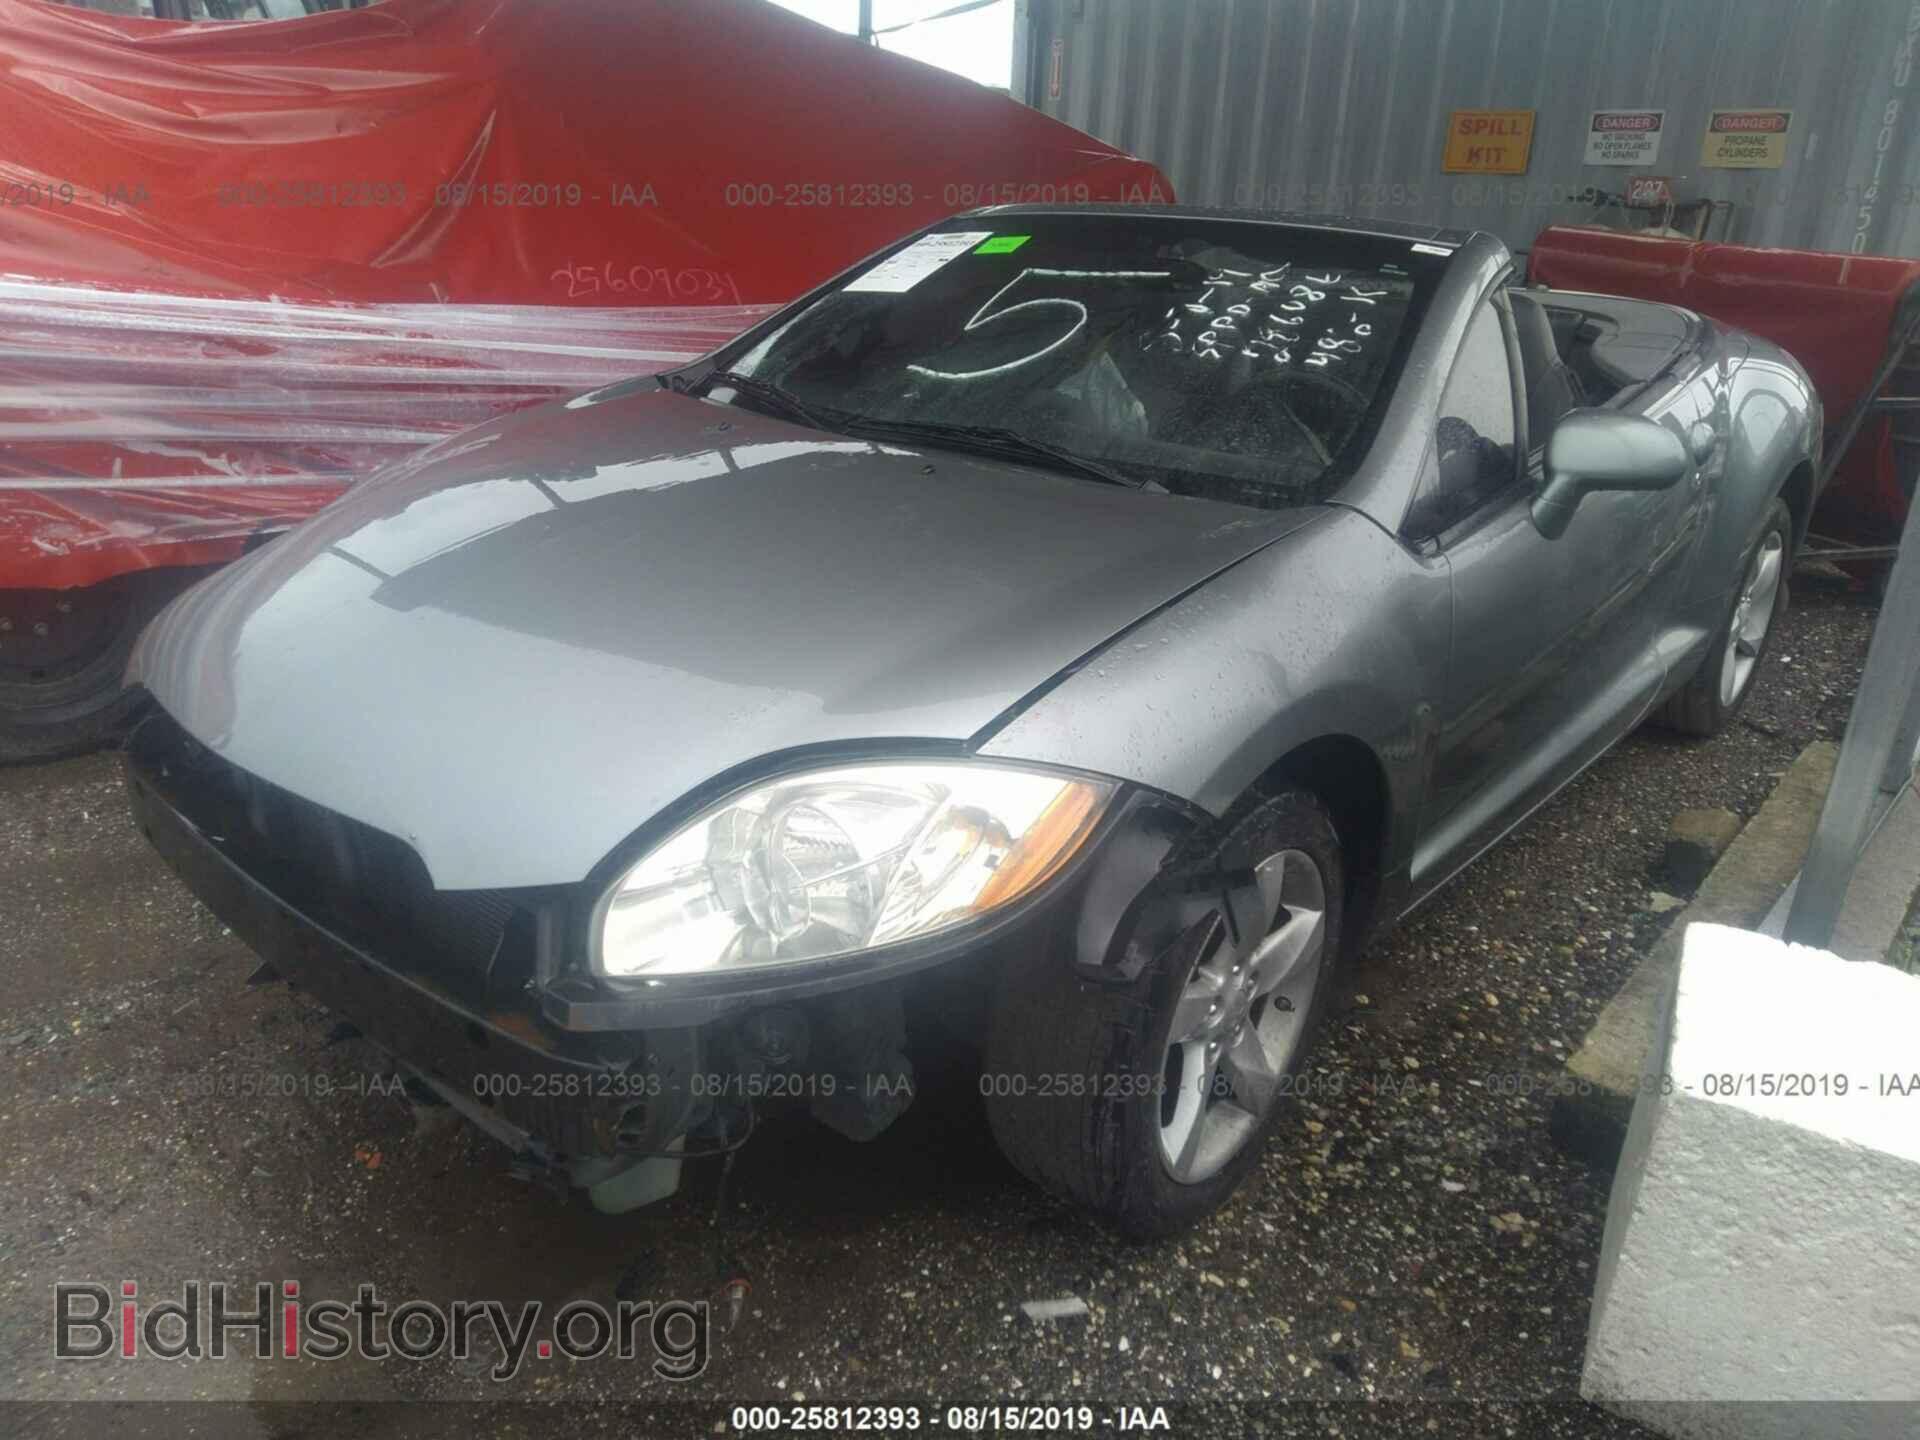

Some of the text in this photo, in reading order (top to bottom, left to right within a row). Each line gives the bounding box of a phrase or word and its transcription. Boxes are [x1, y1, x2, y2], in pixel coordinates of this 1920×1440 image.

[1459, 119, 1522, 136] SPILL
[1602, 117, 1650, 128] DANGER
[1722, 117, 1777, 129] DANGER
[1724, 136, 1768, 146] PROPANE
[1466, 145, 1507, 163] KIT
[1717, 147, 1768, 158] CYLINDERS
[906, 268, 1171, 378] 5
